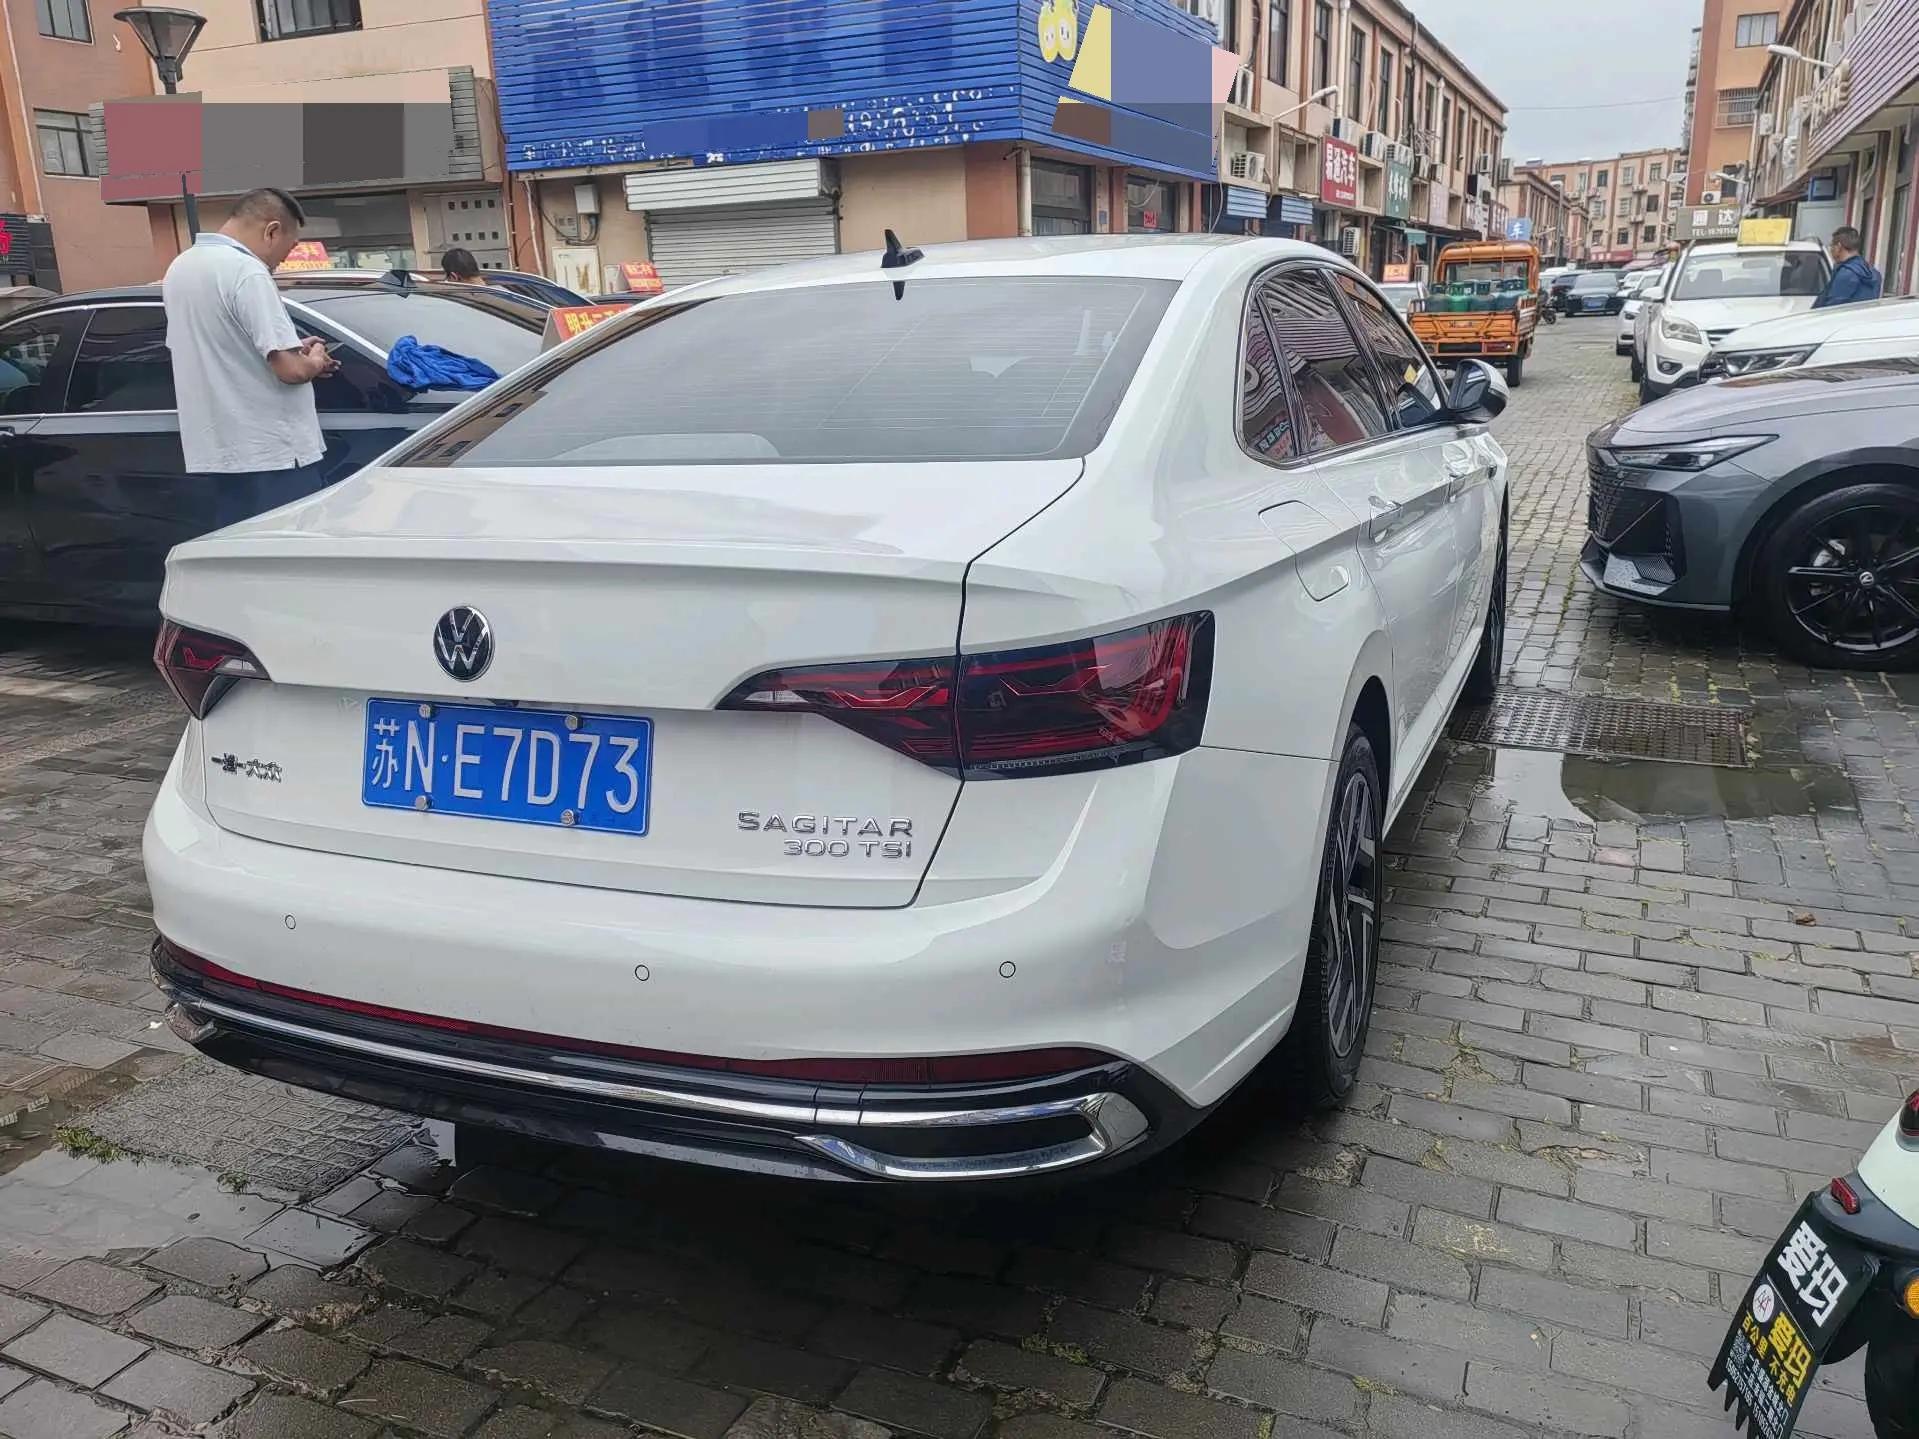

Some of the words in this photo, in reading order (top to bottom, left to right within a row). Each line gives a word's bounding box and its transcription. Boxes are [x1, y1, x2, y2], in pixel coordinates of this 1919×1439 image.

[370, 717, 640, 814] 苏N·E7D73
[737, 810, 913, 837] SAGITAR
[783, 839, 850, 858] 300
[858, 840, 913, 859] TSI
[1777, 1220, 1849, 1328] 爱玛
[1742, 1310, 1769, 1359] 百公里
[1768, 1311, 1812, 1389] 爱玛
